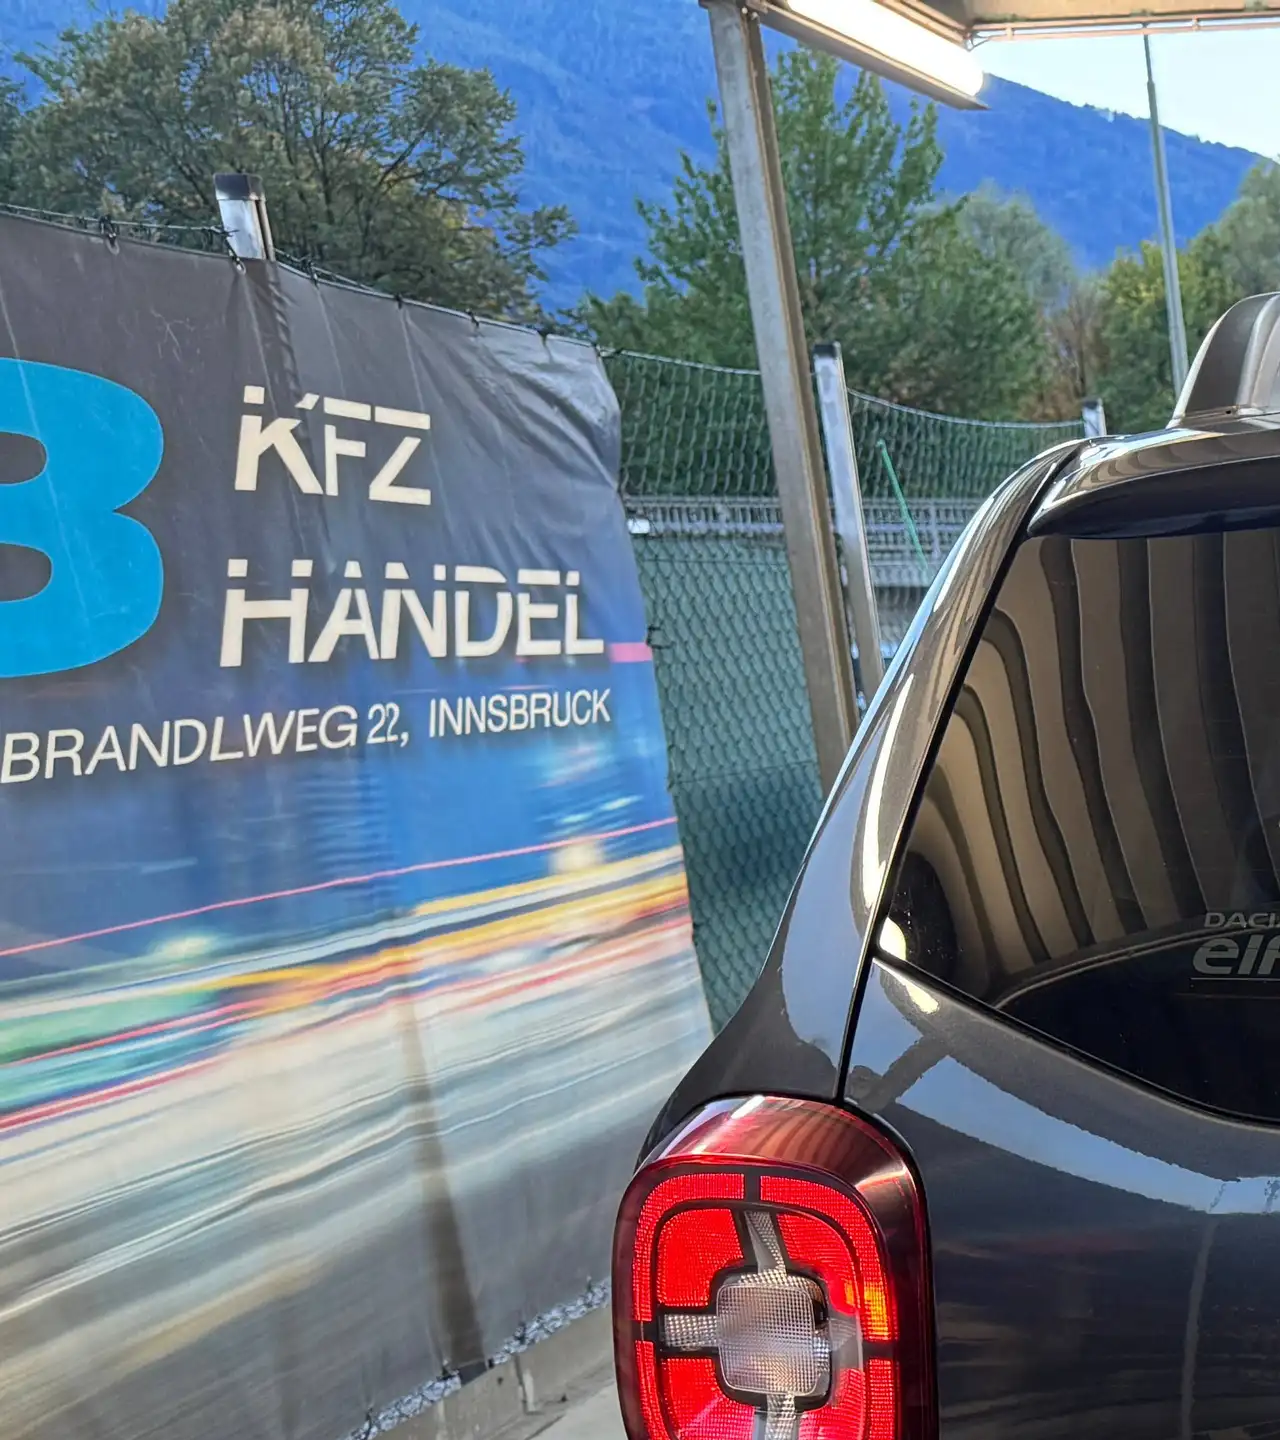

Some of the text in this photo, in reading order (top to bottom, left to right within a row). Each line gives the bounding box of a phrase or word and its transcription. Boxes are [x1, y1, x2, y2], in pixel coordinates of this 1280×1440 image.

[234, 385, 432, 506] KFZ
[219, 558, 604, 668] HANDEL
[1, 688, 612, 784] BRANDLWEG 22, INNSBRUCK
